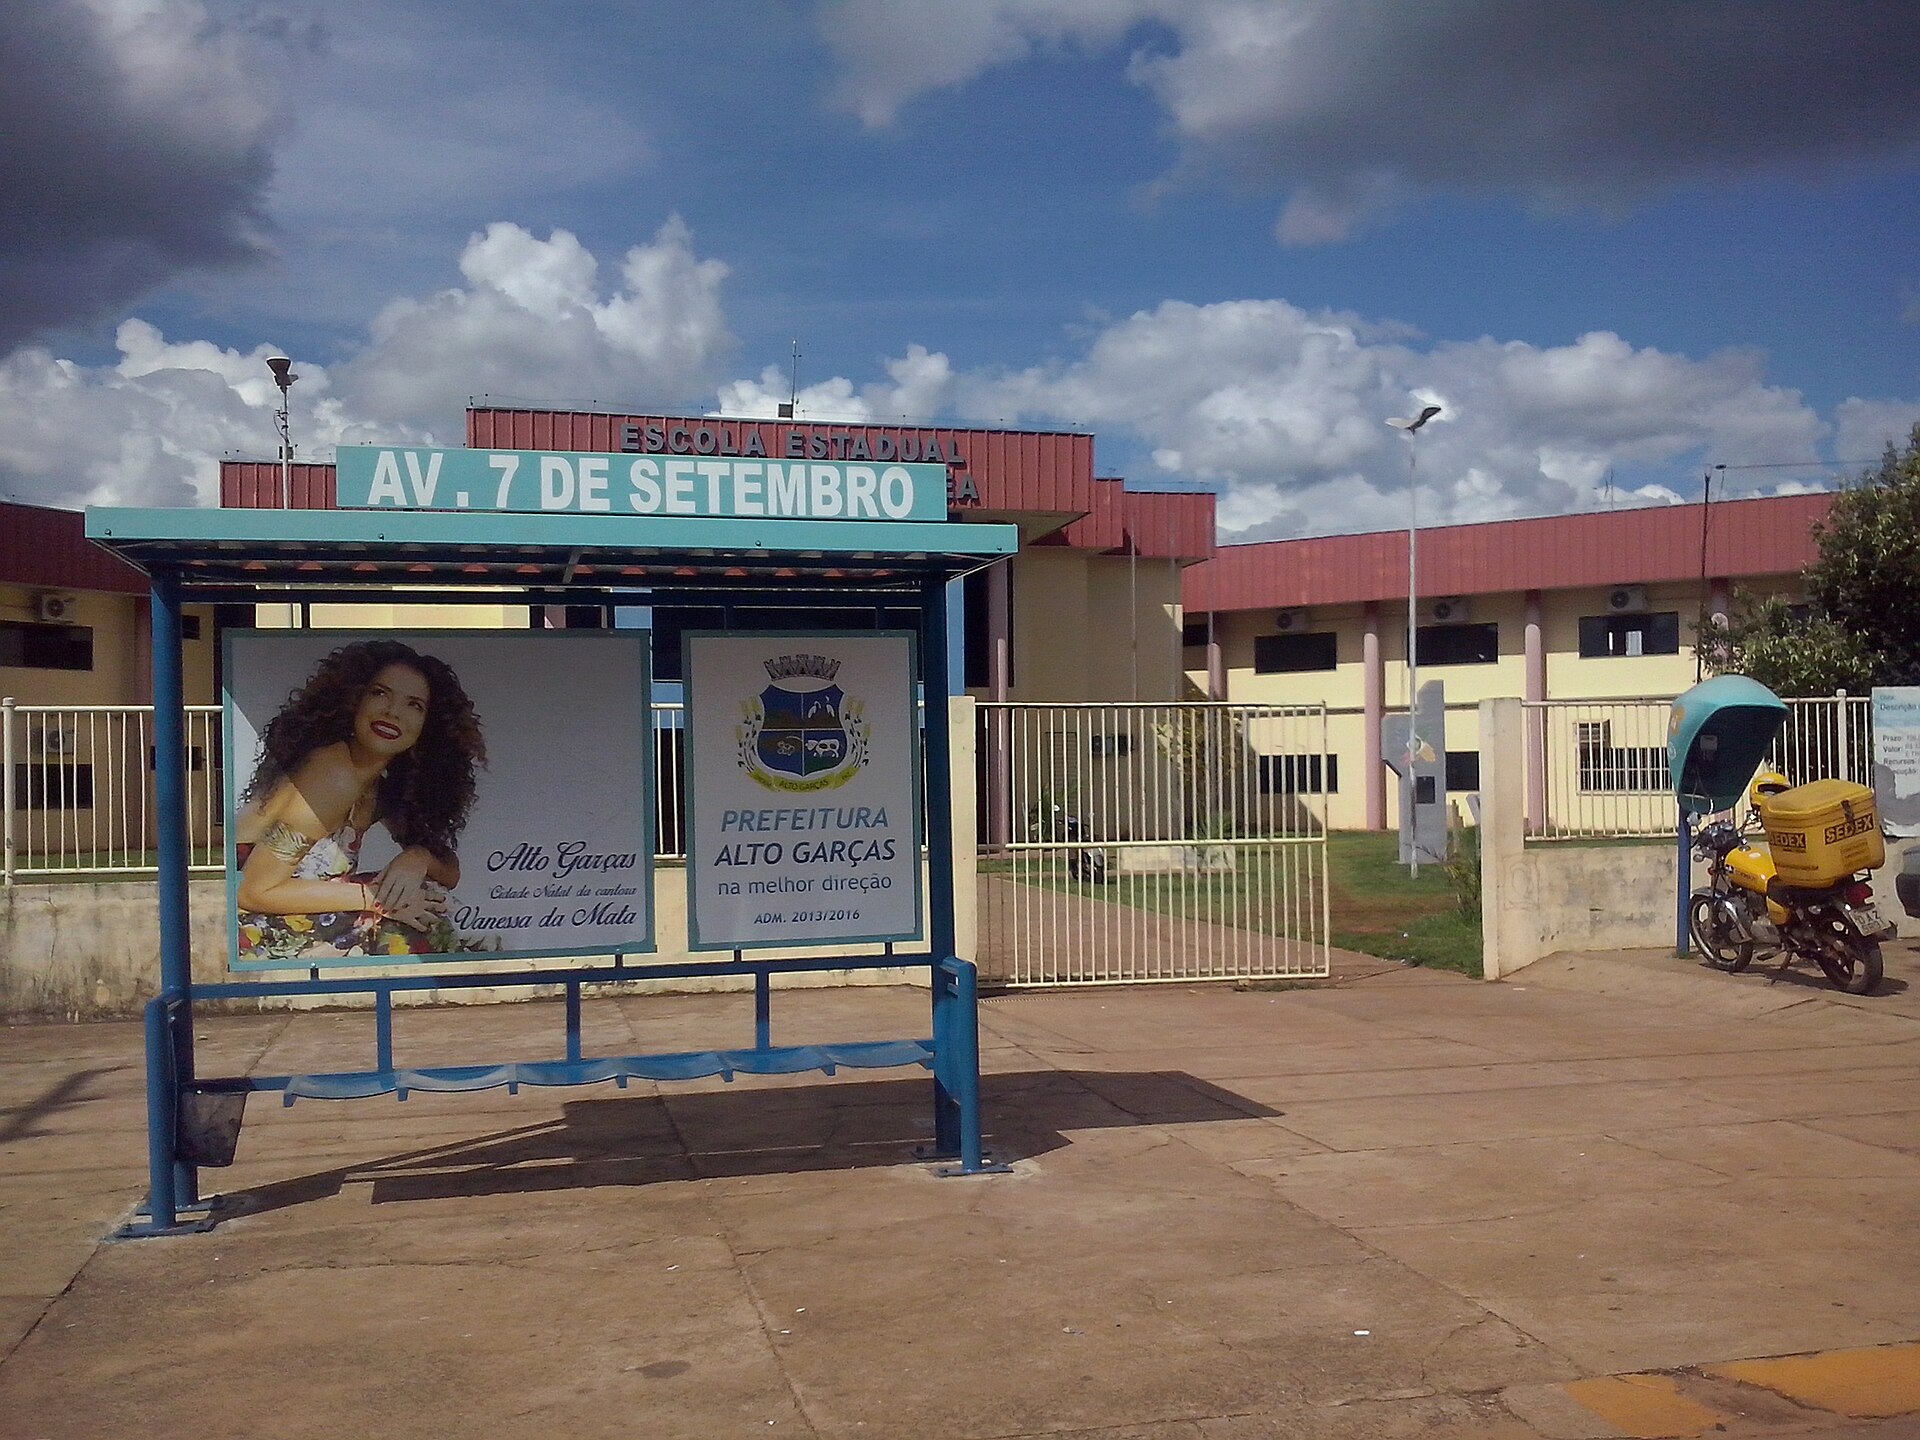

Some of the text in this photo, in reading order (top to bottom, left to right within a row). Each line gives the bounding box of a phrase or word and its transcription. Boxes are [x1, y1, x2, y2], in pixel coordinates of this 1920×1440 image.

[619, 423, 966, 465] ESCOLA ESTADUAL
[489, 454, 519, 509] 7
[540, 456, 611, 512] DE
[629, 458, 914, 519] SETEMBRO
[720, 806, 889, 832] PREFEITURA
[1824, 813, 1874, 844] SEDEX
[486, 840, 637, 879] Alto Garças
[714, 838, 896, 868] ALTO GARÇAS
[490, 884, 529, 900] Cidade
[533, 883, 573, 898] Natal
[718, 872, 892, 896] na melhor direção
[454, 901, 637, 931] Vanessa da Mata
[754, 909, 860, 925] ADM. 2013/2016
